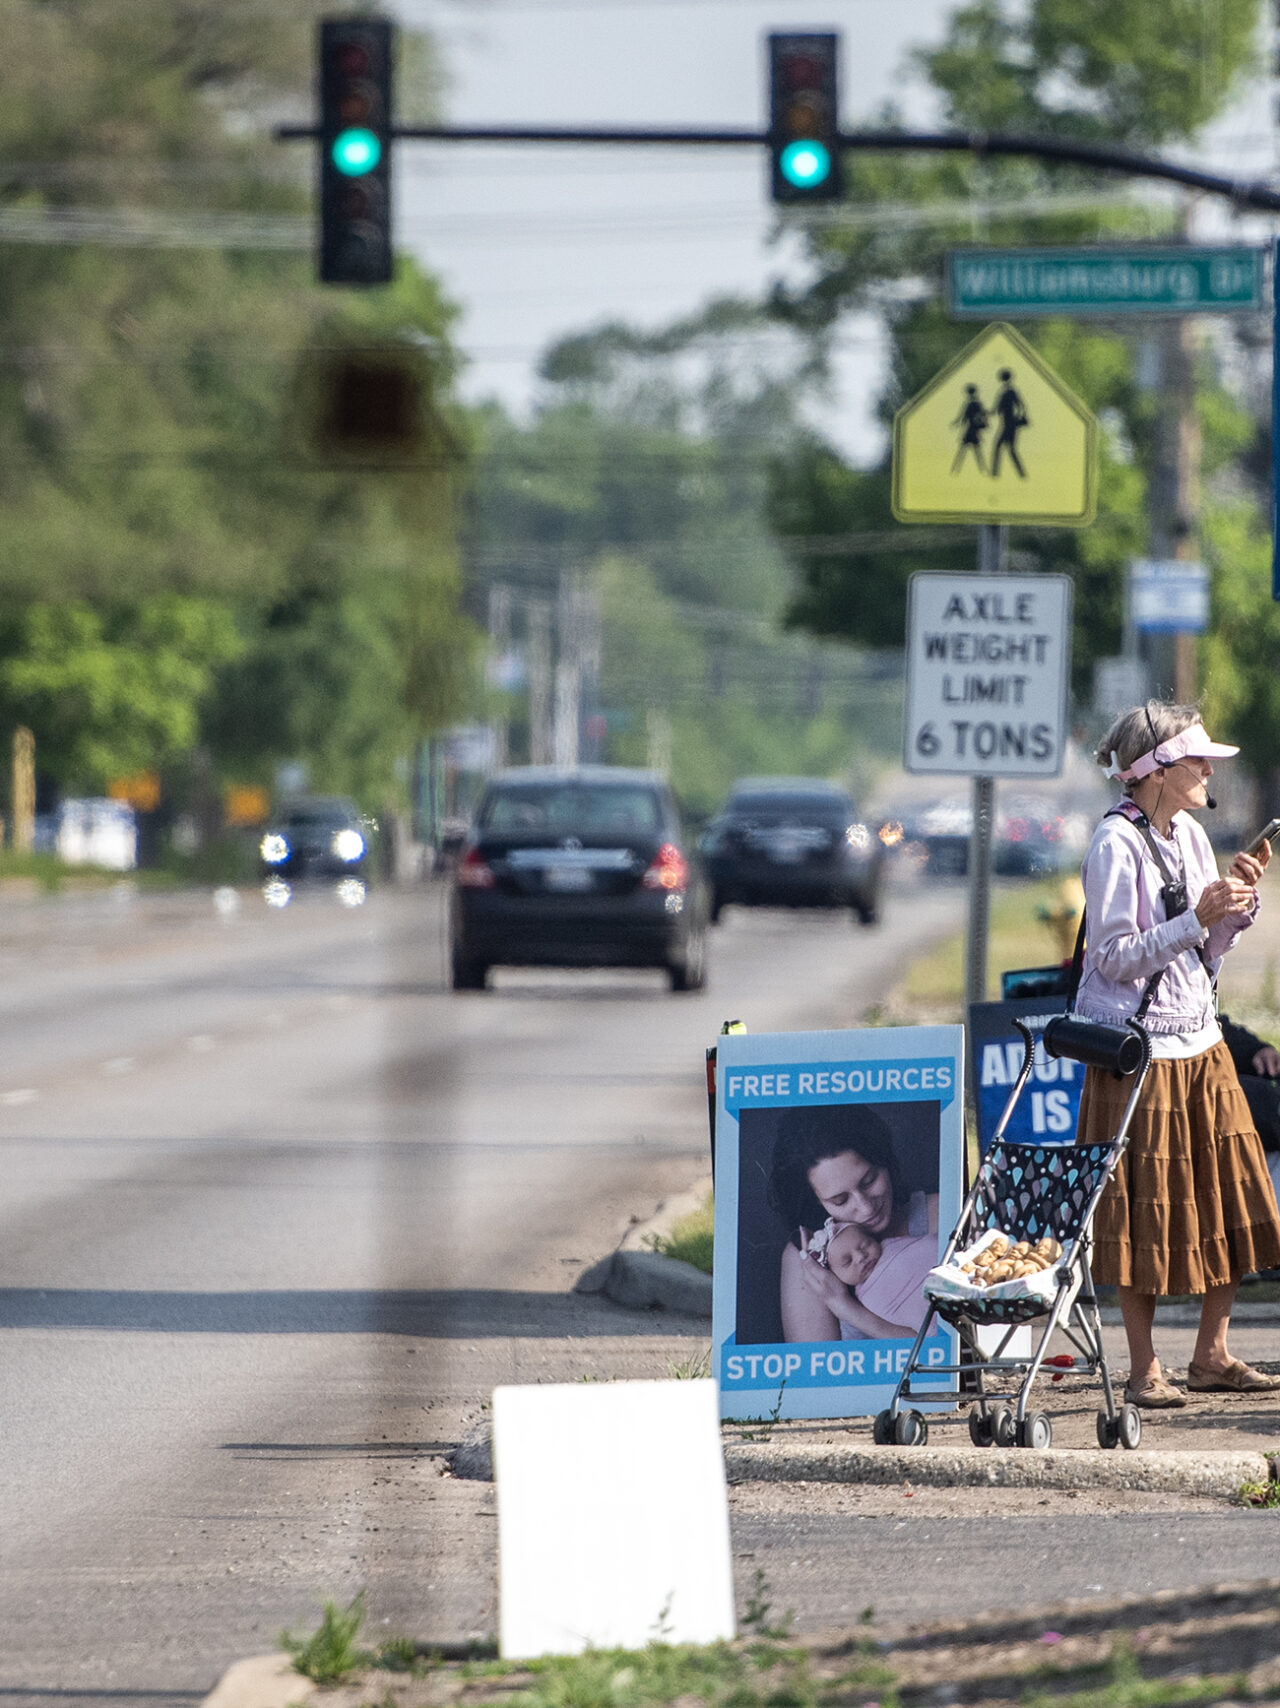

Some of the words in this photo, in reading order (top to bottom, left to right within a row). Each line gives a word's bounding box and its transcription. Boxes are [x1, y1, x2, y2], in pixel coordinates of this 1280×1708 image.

[961, 264, 1197, 303] Williamsburg
[942, 592, 1036, 624] AXLE
[924, 632, 1049, 666] WEIGHT
[942, 674, 1029, 703] LIMIT
[916, 720, 940, 757] 6
[952, 720, 1053, 759] TONS
[728, 1073, 791, 1098] FREE
[798, 1066, 952, 1095] RESOURCES
[1031, 1089, 1073, 1134] IS
[726, 1353, 801, 1380] STOP
[810, 1351, 865, 1377] FOR
[874, 1347, 945, 1374] HEP
